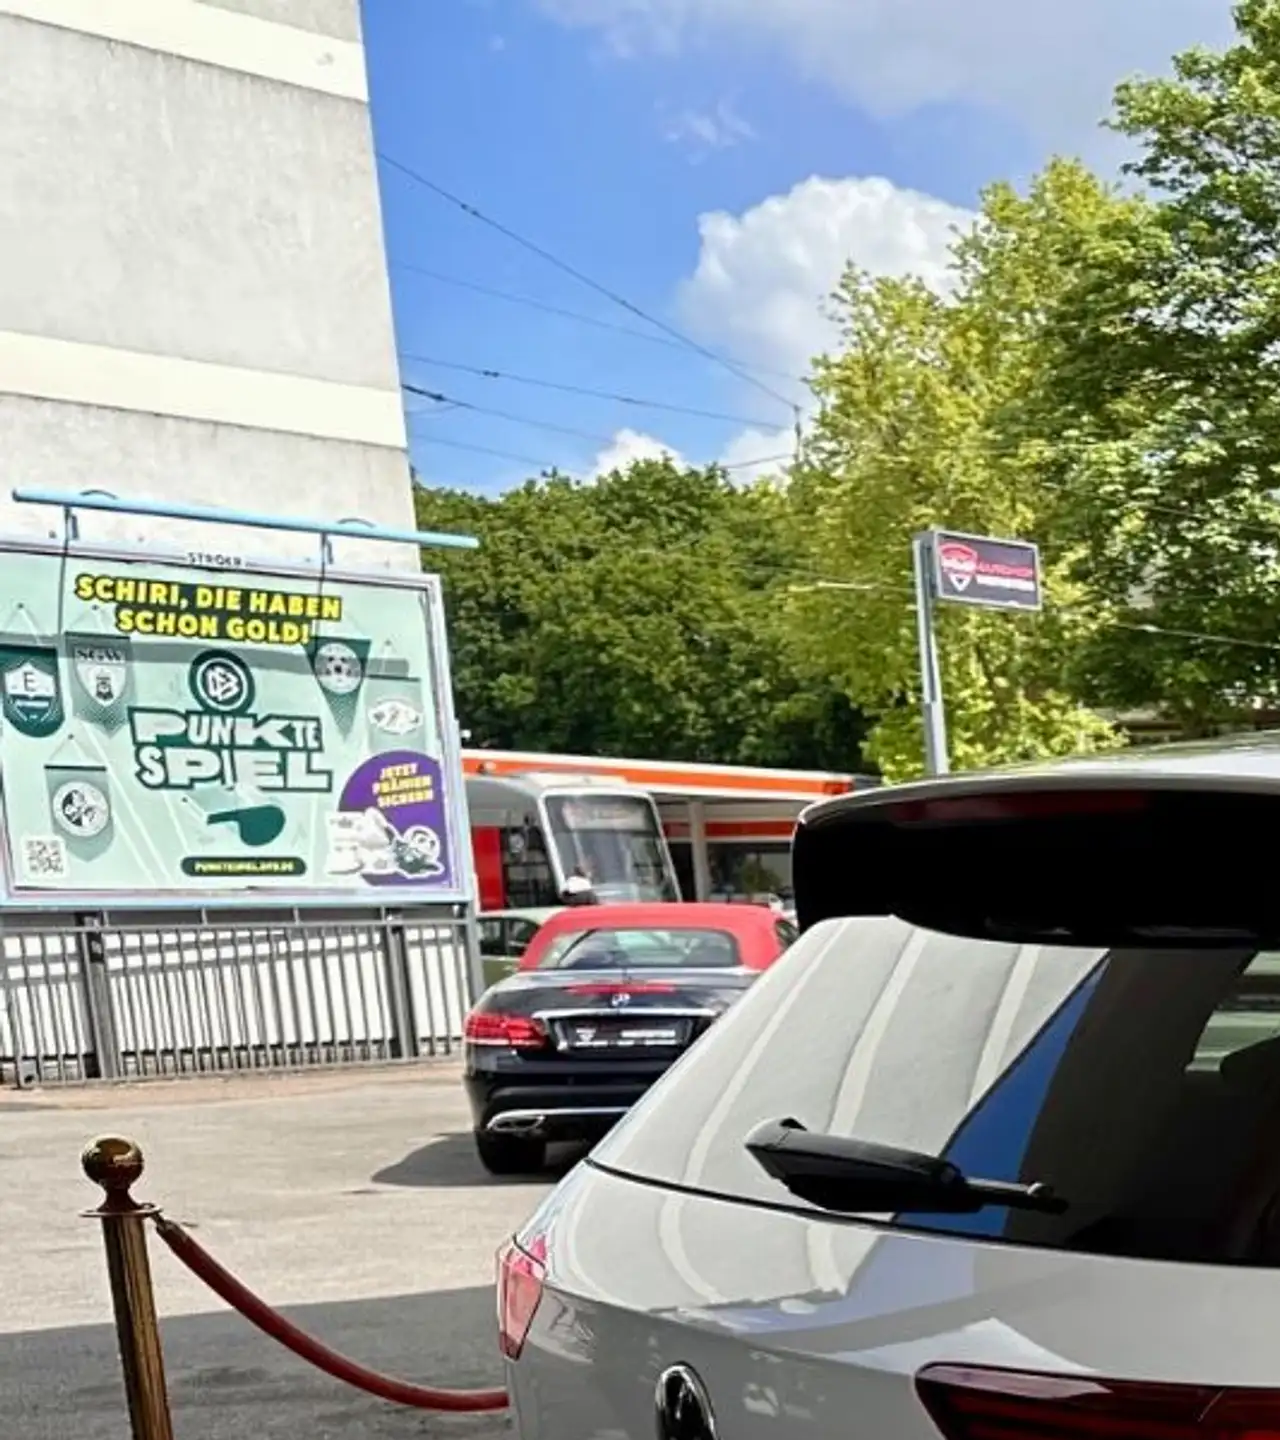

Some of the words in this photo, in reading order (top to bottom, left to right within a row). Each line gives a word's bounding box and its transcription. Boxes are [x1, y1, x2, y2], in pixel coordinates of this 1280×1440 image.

[76, 575, 188, 610] SCHIRI,
[195, 586, 242, 611] DIE
[249, 592, 341, 619] HABEN
[117, 609, 218, 637] SCHON
[226, 618, 310, 644] GOLD!
[129, 707, 323, 751] PUNKTE
[135, 745, 332, 792] SPIEL
